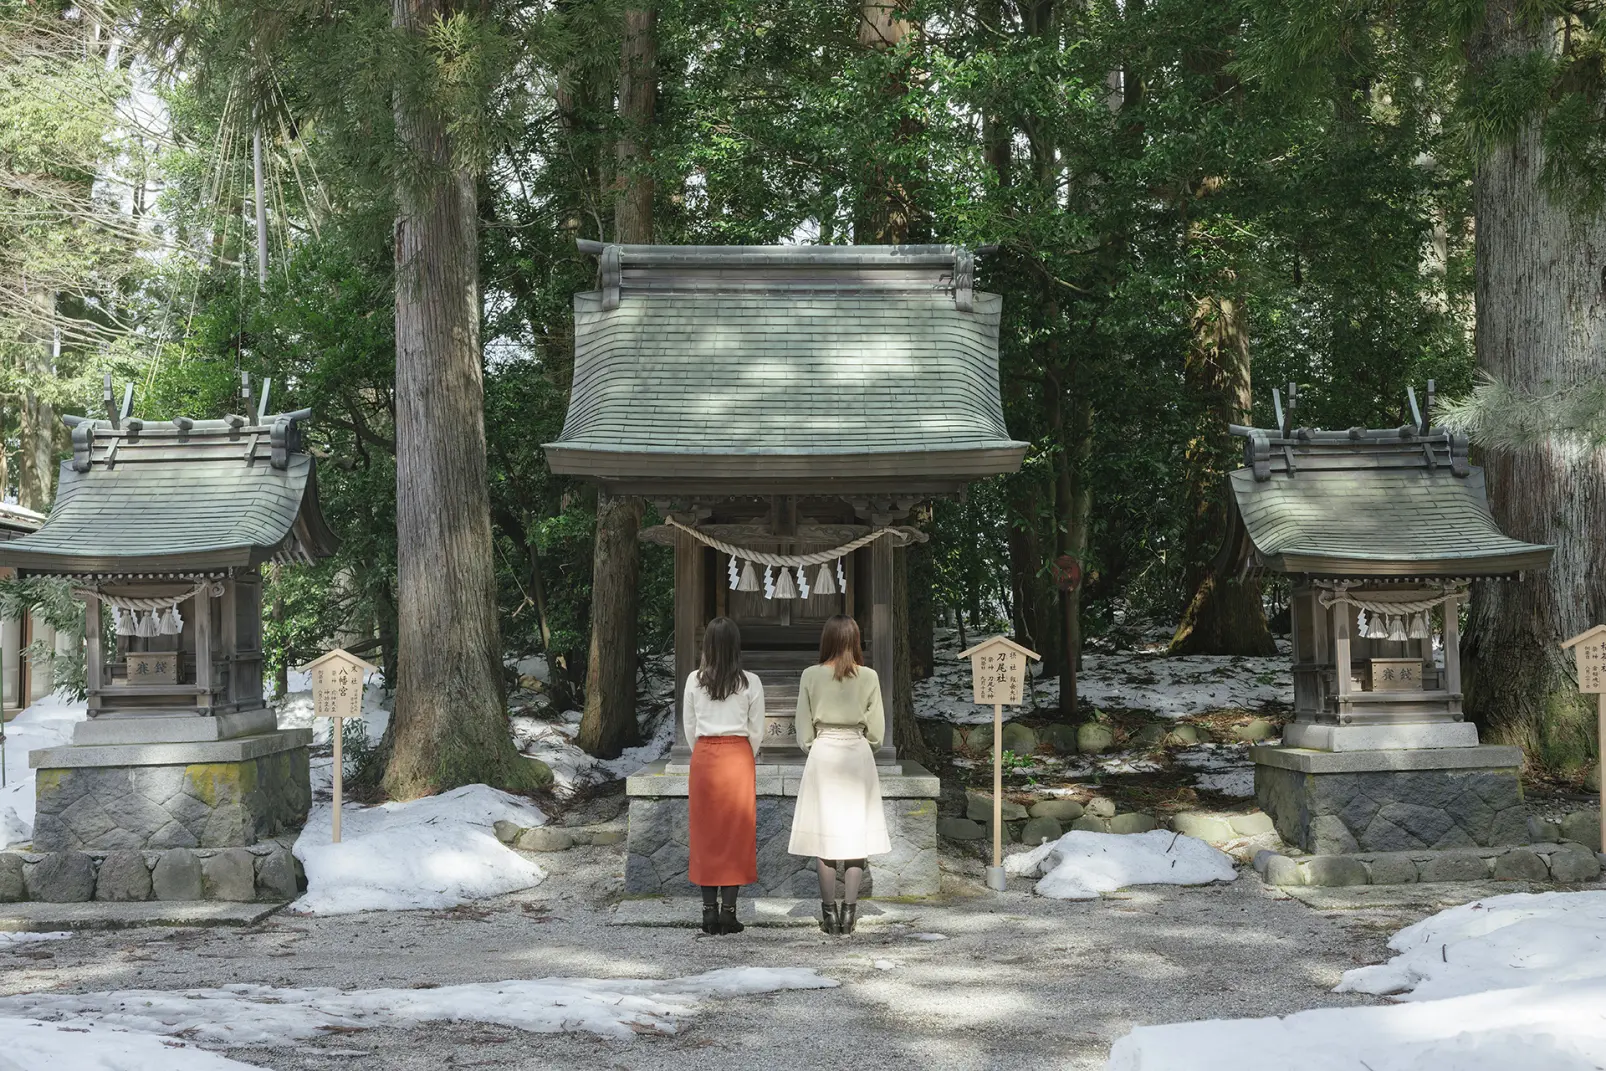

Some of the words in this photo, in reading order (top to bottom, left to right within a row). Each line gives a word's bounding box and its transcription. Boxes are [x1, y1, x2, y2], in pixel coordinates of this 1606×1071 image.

[338, 666, 348, 696] 八幡宮
[996, 653, 1006, 682] 刀尾社
